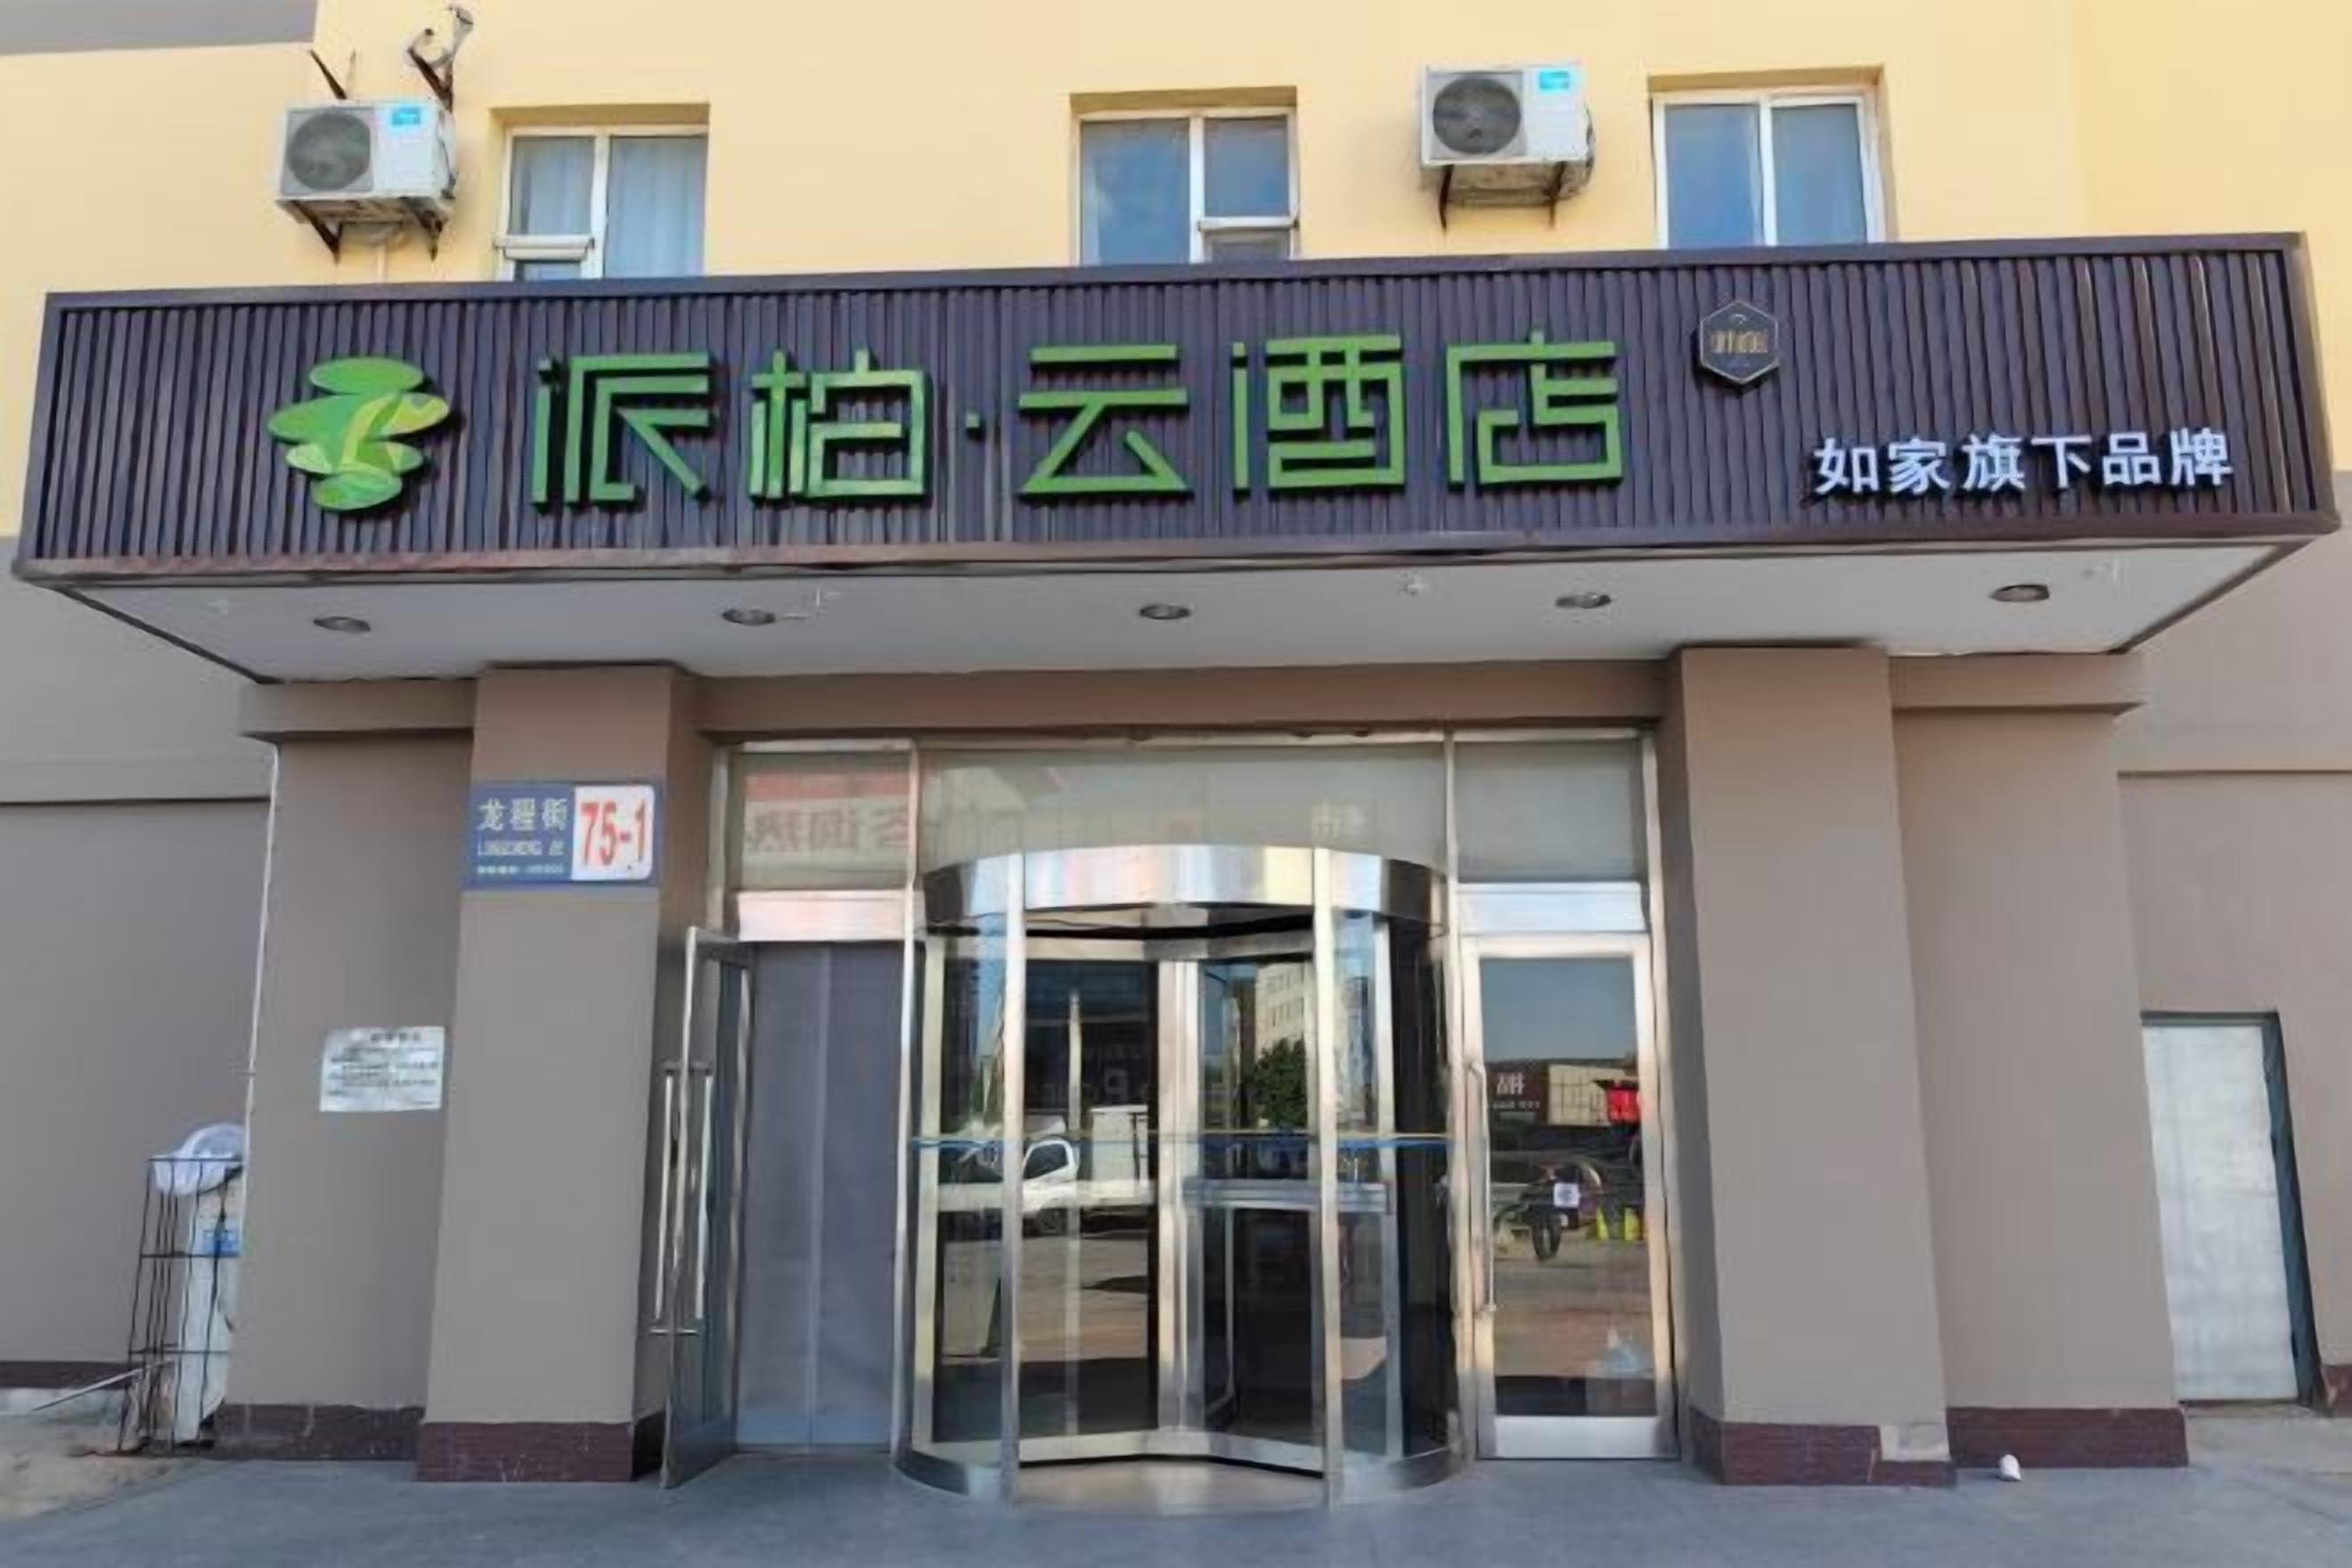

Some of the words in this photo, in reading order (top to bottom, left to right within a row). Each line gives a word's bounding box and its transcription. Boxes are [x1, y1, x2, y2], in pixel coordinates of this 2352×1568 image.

[1813, 428, 2234, 495] 如家旗下品牌
[581, 800, 646, 866] 75-1
